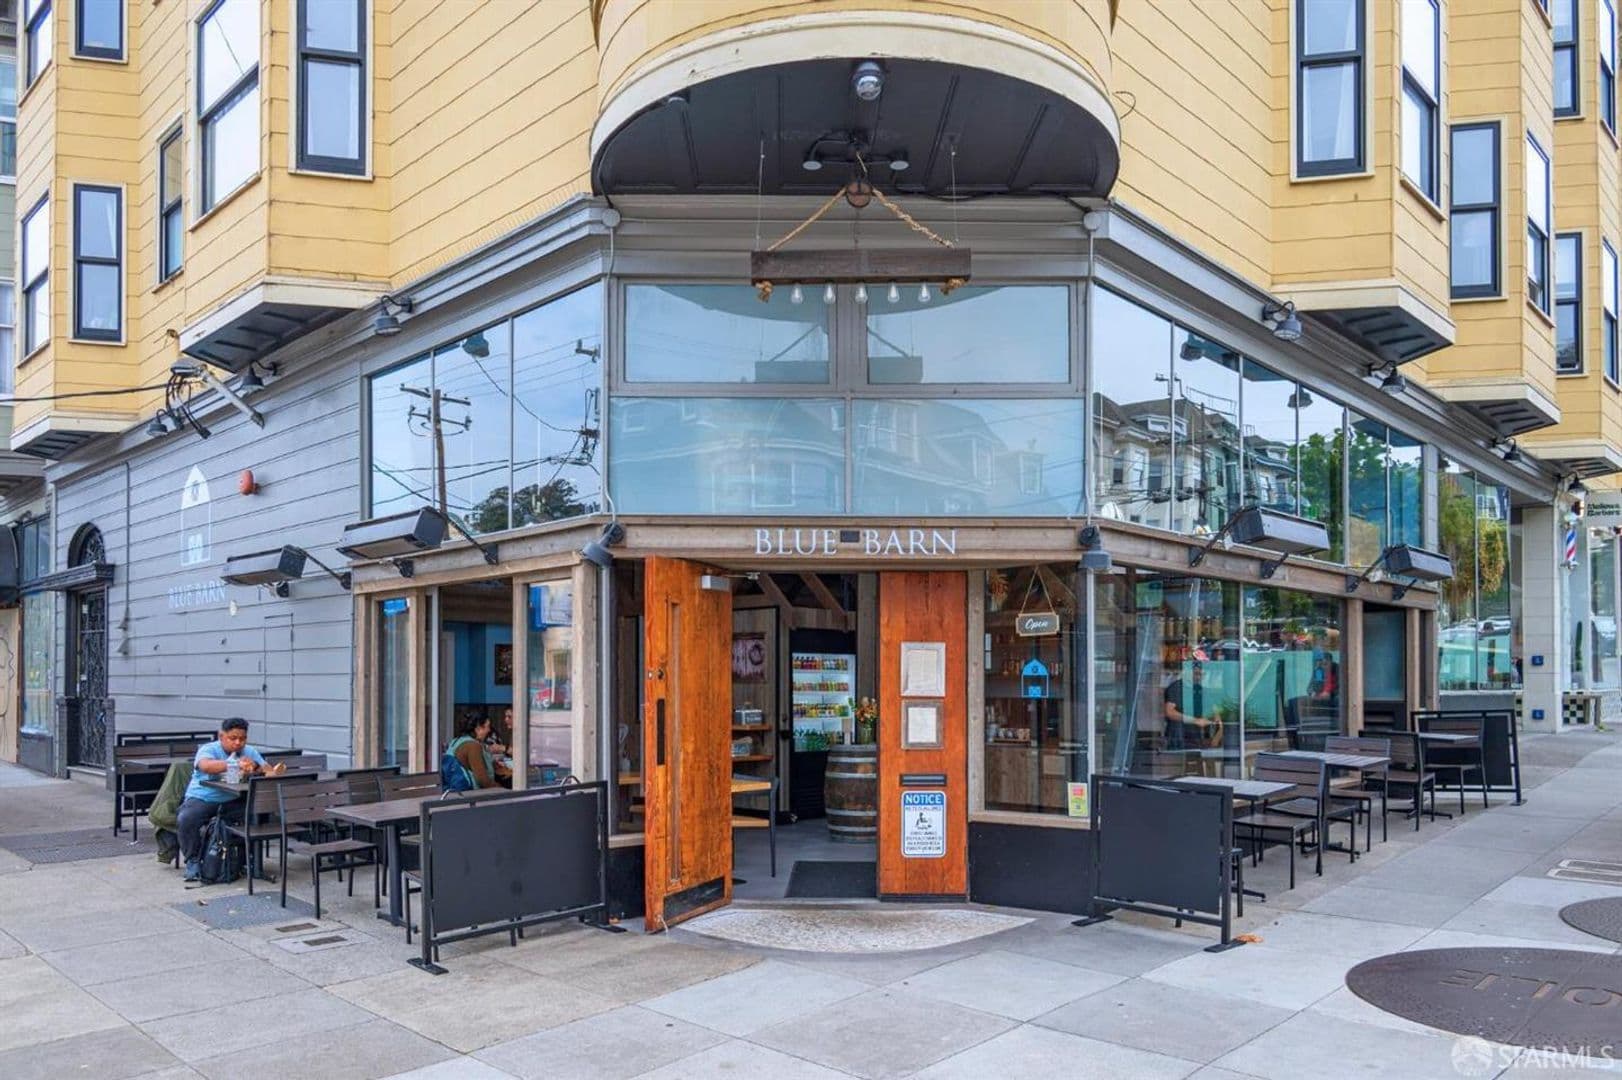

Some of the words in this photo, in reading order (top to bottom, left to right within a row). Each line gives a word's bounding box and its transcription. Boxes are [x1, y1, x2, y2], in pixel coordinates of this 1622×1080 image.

[754, 528, 837, 555] BLUE
[864, 528, 959, 556] BARN
[168, 583, 193, 609] BLUE
[195, 580, 227, 604] BARN
[1025, 617, 1049, 631] Open
[905, 794, 942, 805] NOTICE
